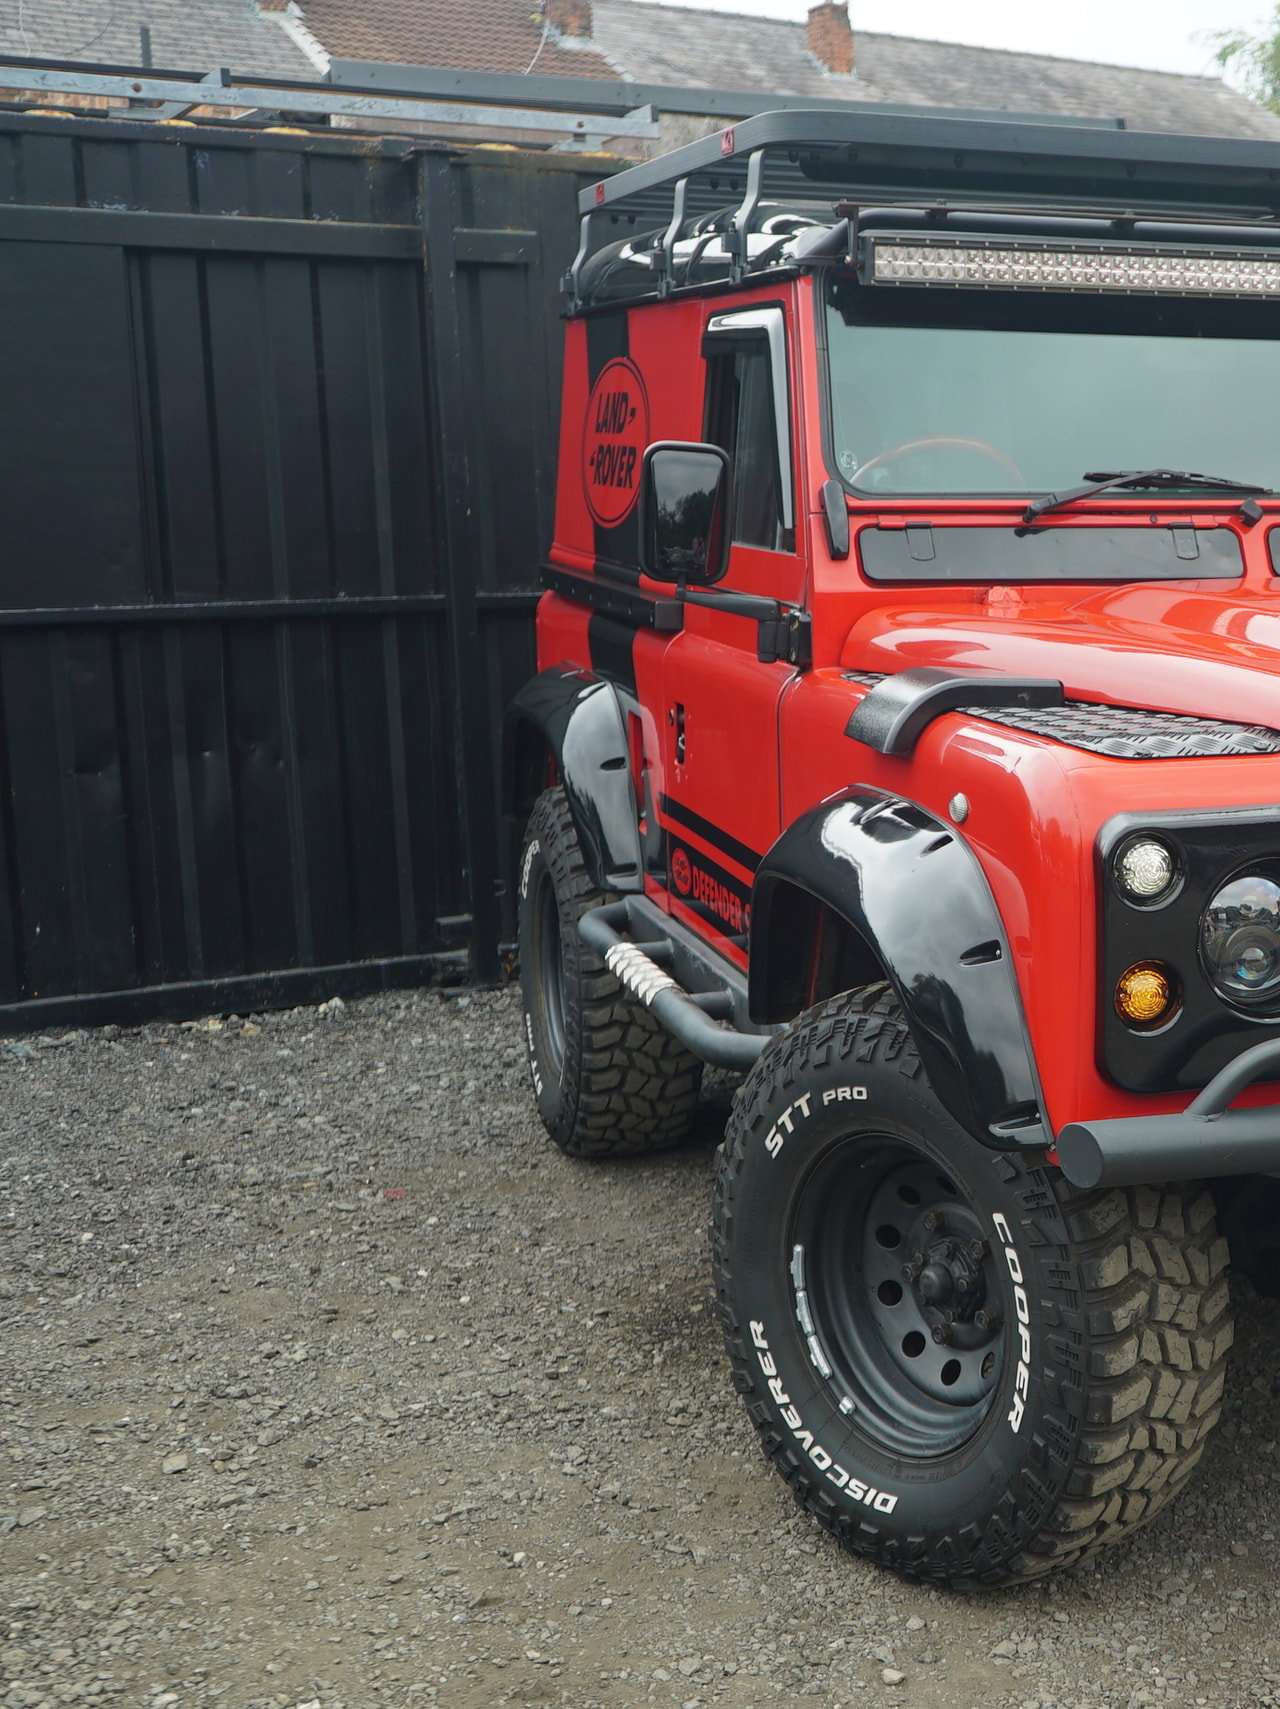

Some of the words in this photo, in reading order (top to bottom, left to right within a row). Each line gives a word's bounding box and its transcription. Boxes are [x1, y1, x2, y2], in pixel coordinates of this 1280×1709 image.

[595, 392, 629, 433] LAND
[594, 444, 637, 488] ROVER
[692, 865, 743, 933] DEFENDER
[764, 1092, 812, 1160] STT
[822, 1085, 868, 1106] PRO
[991, 1211, 1032, 1435] COOPER
[748, 1319, 899, 1516] DISCOVERER
